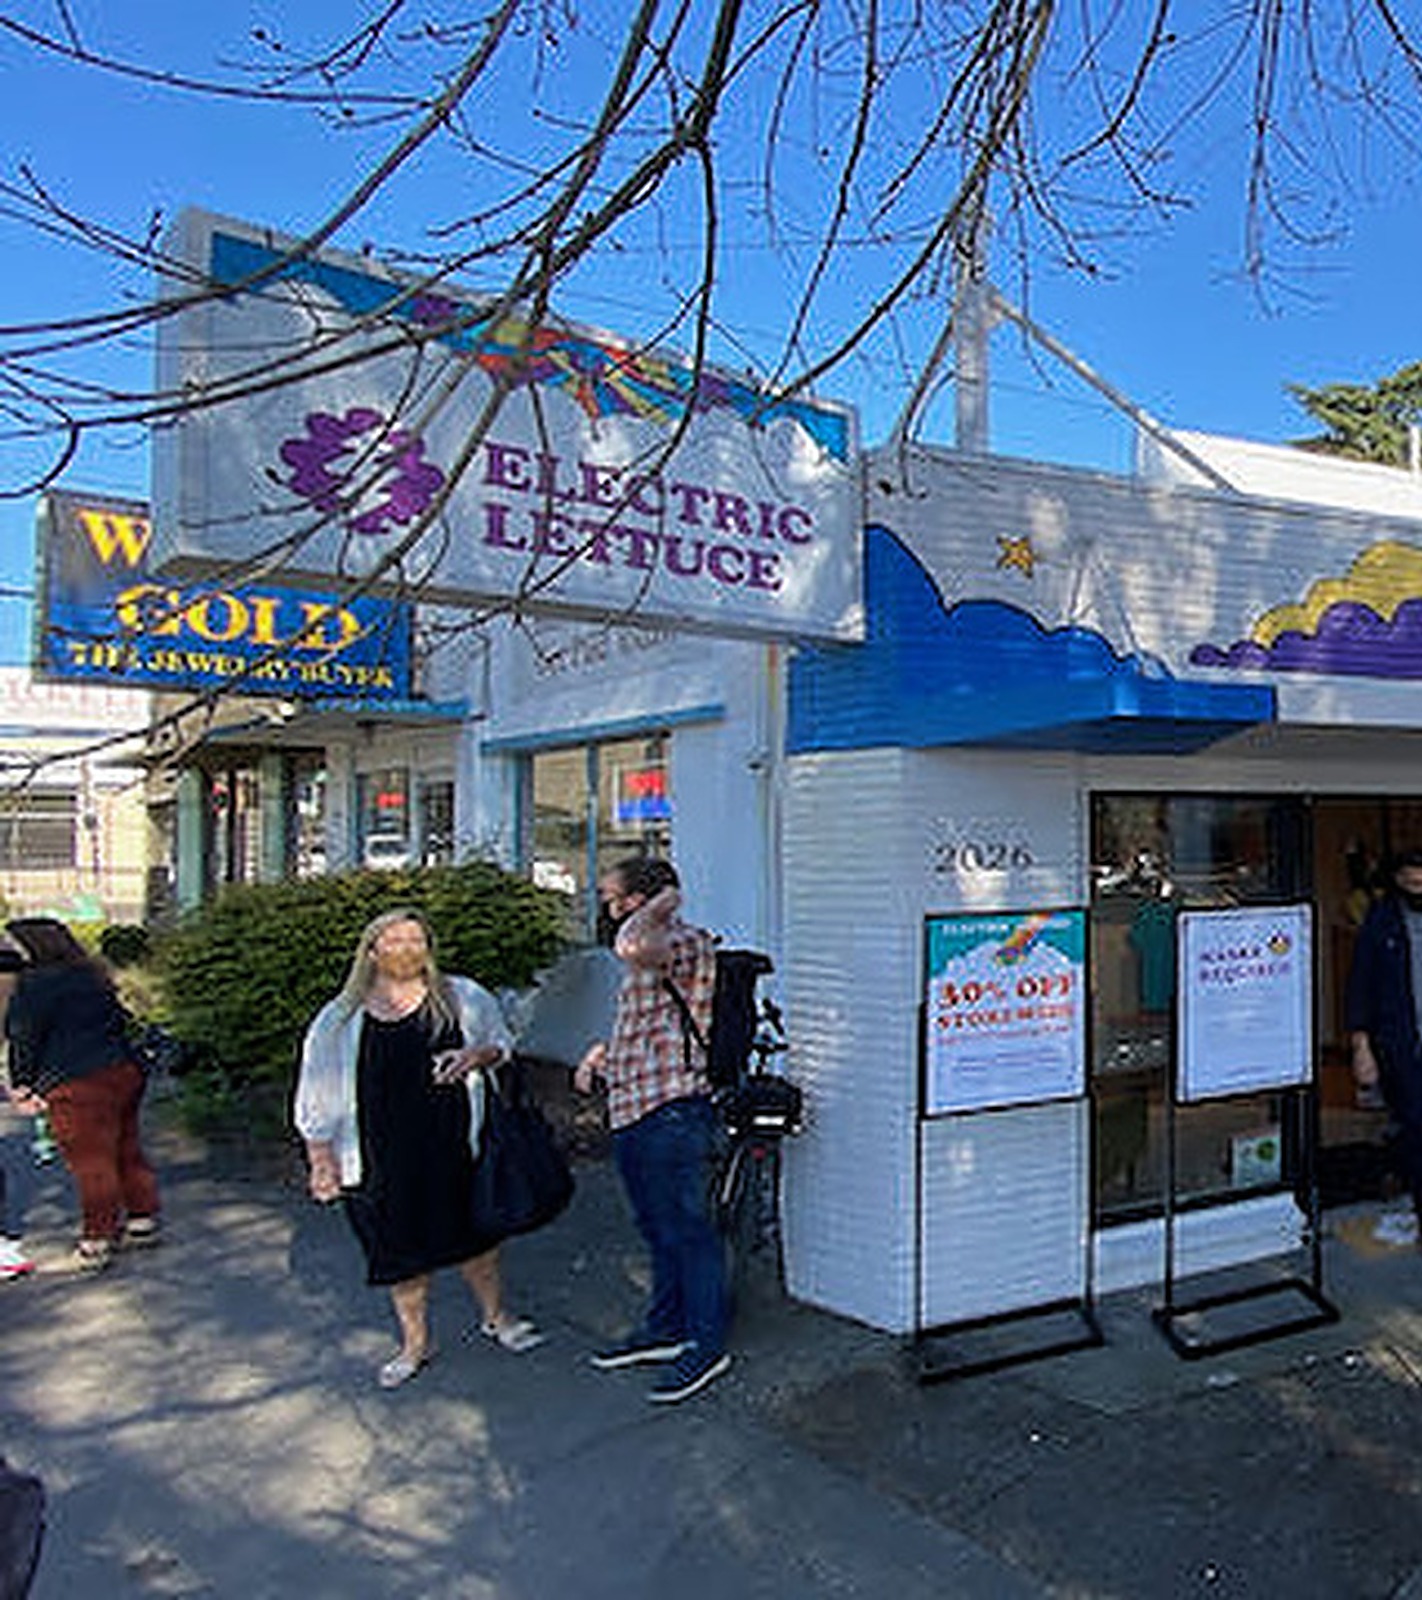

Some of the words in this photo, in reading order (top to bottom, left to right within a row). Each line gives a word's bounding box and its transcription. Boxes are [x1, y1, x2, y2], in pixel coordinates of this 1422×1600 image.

[483, 440, 813, 545] ELECTRIC
[483, 502, 784, 592] LETTUCE
[115, 583, 361, 652] GOLD
[301, 661, 394, 689] BUYER
[934, 843, 1034, 873] 2026
[1015, 971, 1076, 1000] OFF
